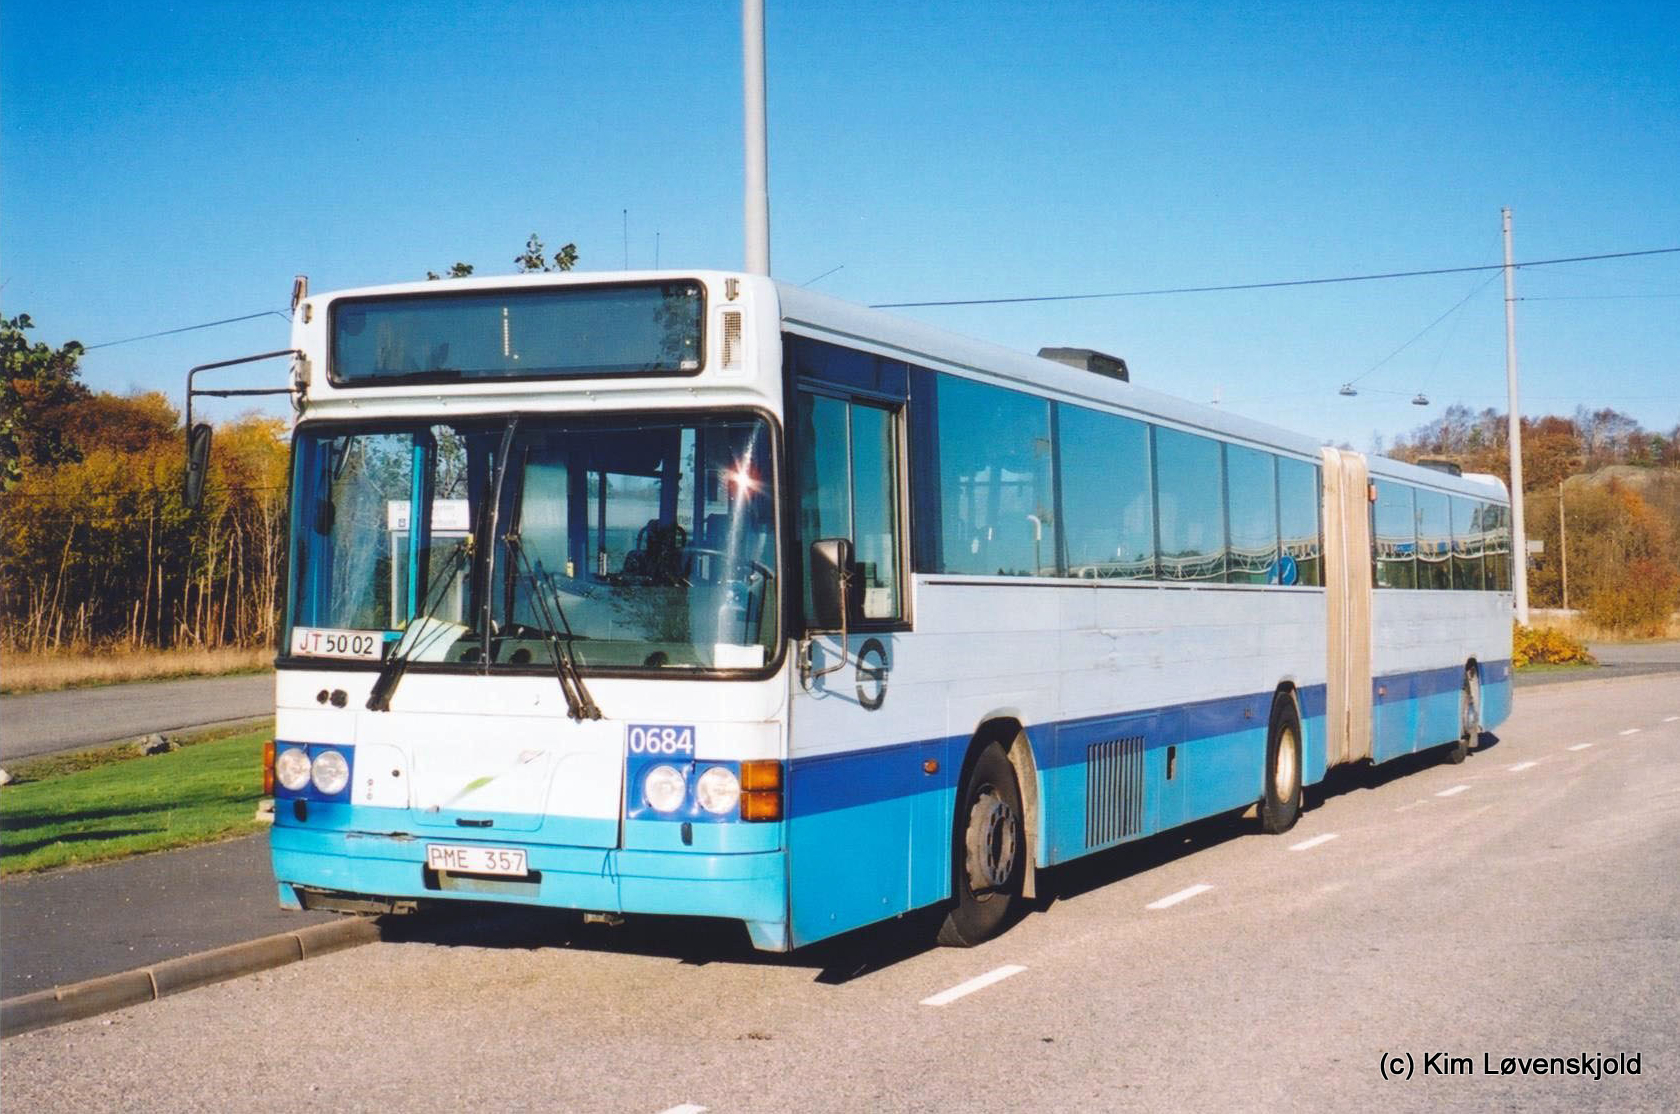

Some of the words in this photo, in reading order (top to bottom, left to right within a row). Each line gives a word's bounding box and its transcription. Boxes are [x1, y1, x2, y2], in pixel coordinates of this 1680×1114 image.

[300, 632, 322, 652] JT
[630, 727, 693, 754] 0684
[430, 848, 469, 869] PME
[485, 851, 524, 871] 357
